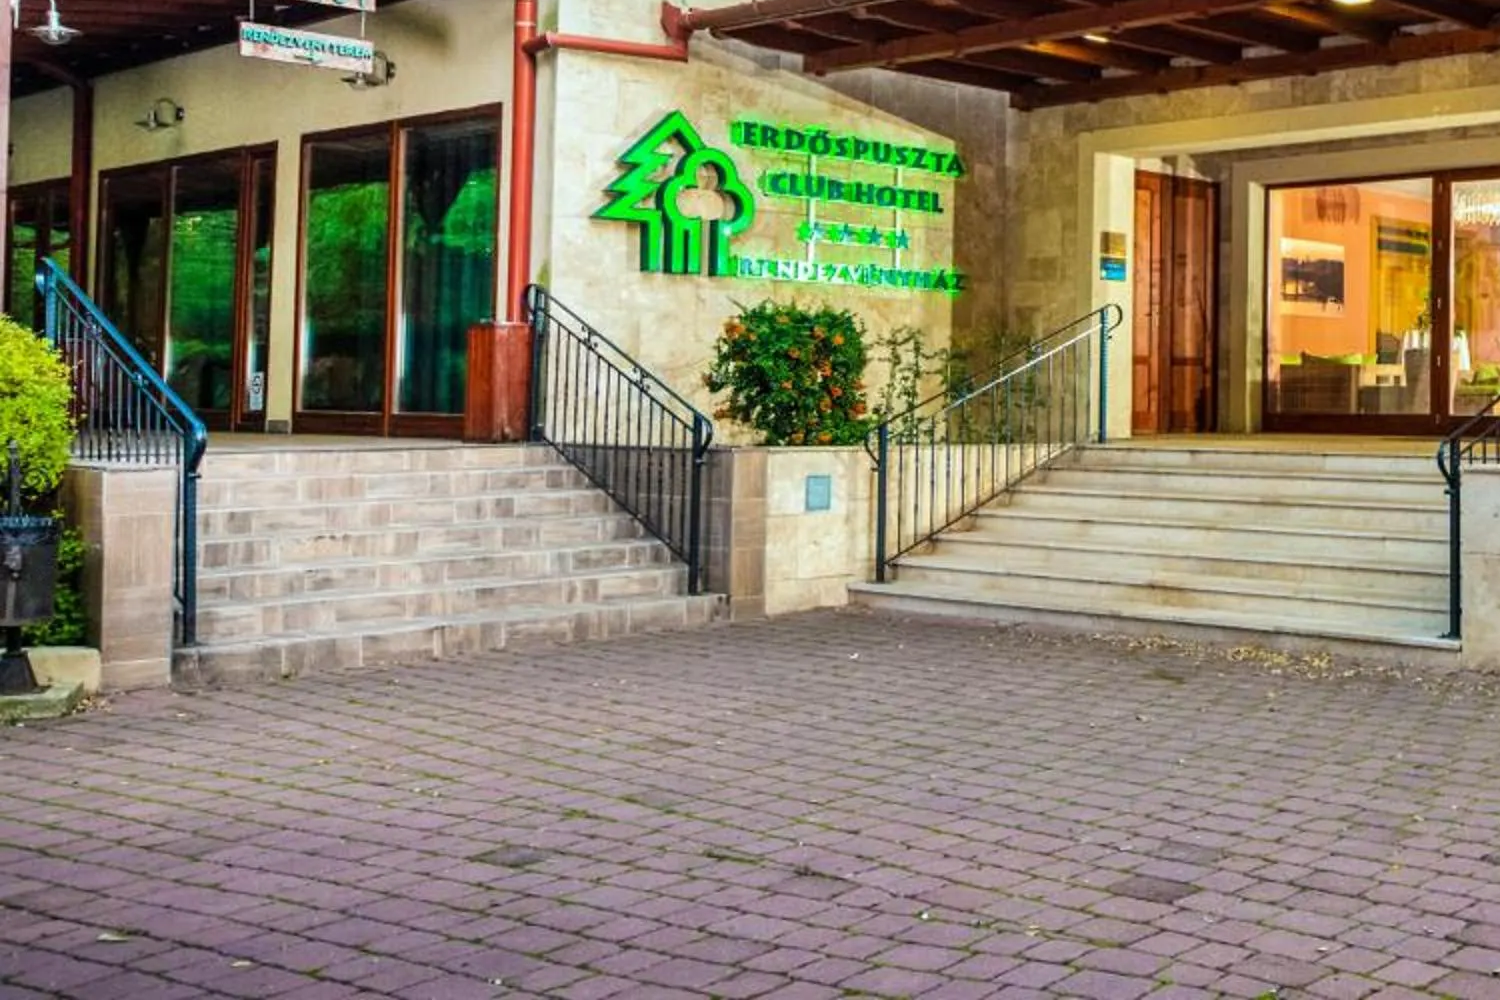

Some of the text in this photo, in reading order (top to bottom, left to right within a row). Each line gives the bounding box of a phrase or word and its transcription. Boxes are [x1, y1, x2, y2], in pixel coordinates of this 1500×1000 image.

[732, 120, 965, 177] ERDŐSPUSZTA
[759, 170, 944, 214] CLUB HOTEL
